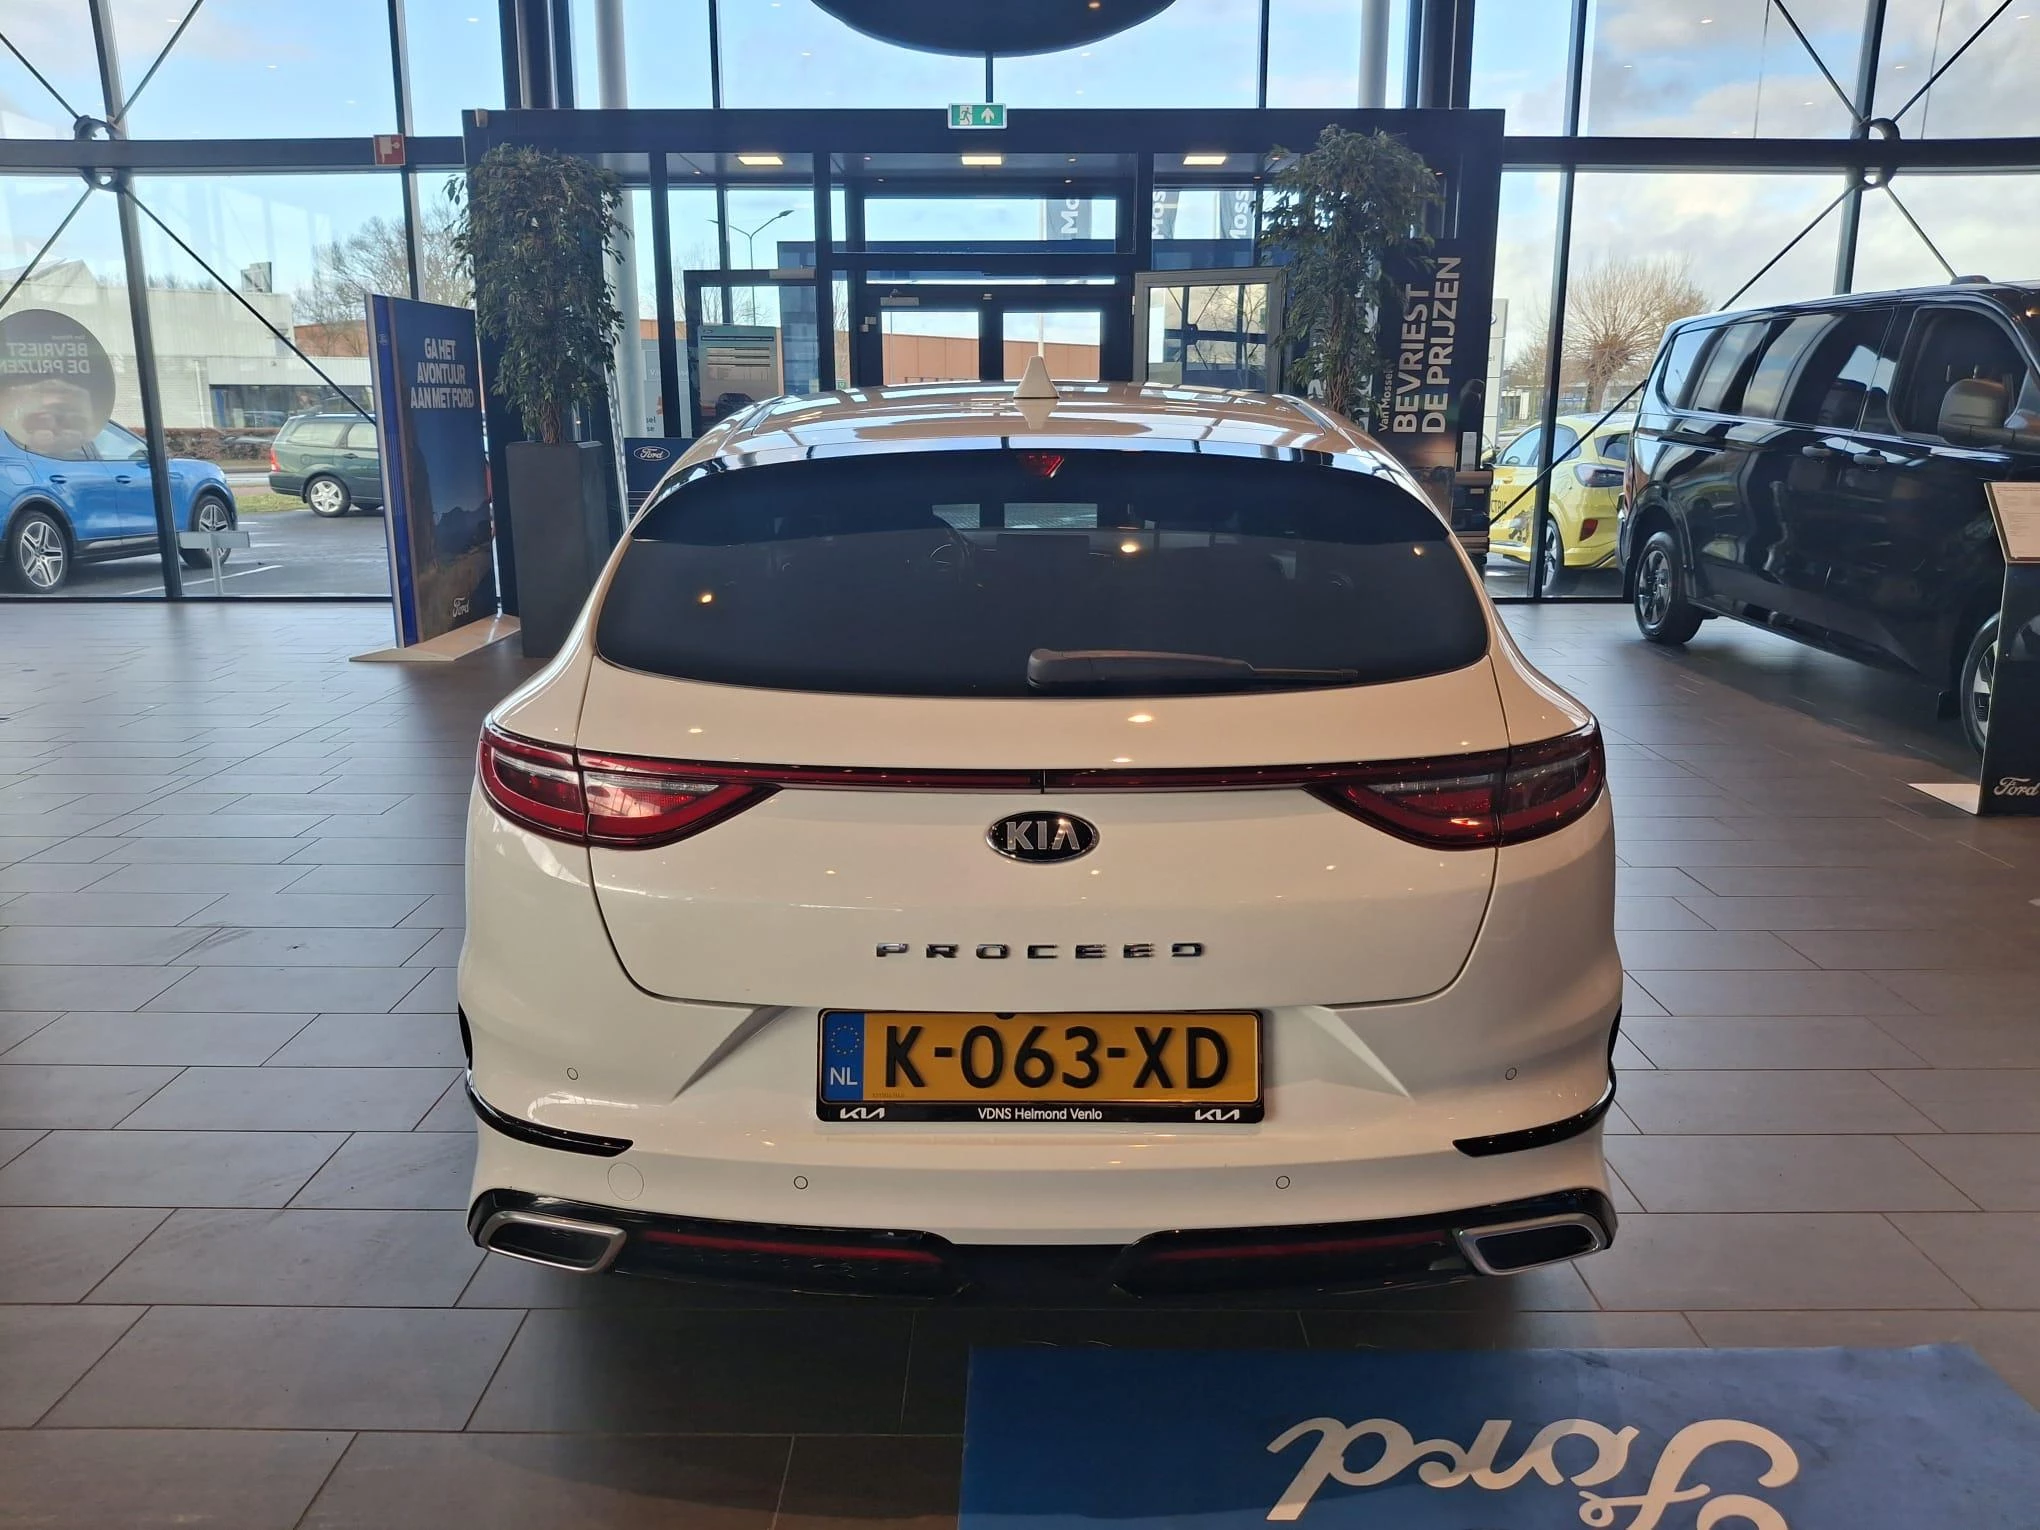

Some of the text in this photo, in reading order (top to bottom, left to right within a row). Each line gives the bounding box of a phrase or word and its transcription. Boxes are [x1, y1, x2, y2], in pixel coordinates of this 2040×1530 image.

[424, 337, 456, 360] GA HET
[1421, 257, 1462, 433] DE PRIJZEN
[1393, 283, 1430, 433] BEVRIEST
[417, 361, 466, 385] AVONTUUR
[410, 387, 475, 409] AAN MET FORD
[1378, 412, 1390, 432] Van
[640, 448, 664, 459] Ford
[453, 596, 470, 618] Ford
[1994, 776, 2040, 797] Ford
[1006, 821, 1080, 850] KIA
[876, 942, 1206, 959] PROCEED
[885, 1025, 1229, 1090] K-063-XD
[830, 1066, 858, 1086] NL
[978, 1107, 1103, 1121] VDNS Helmond Venlo
[1266, 1417, 1799, 1530] Ford
